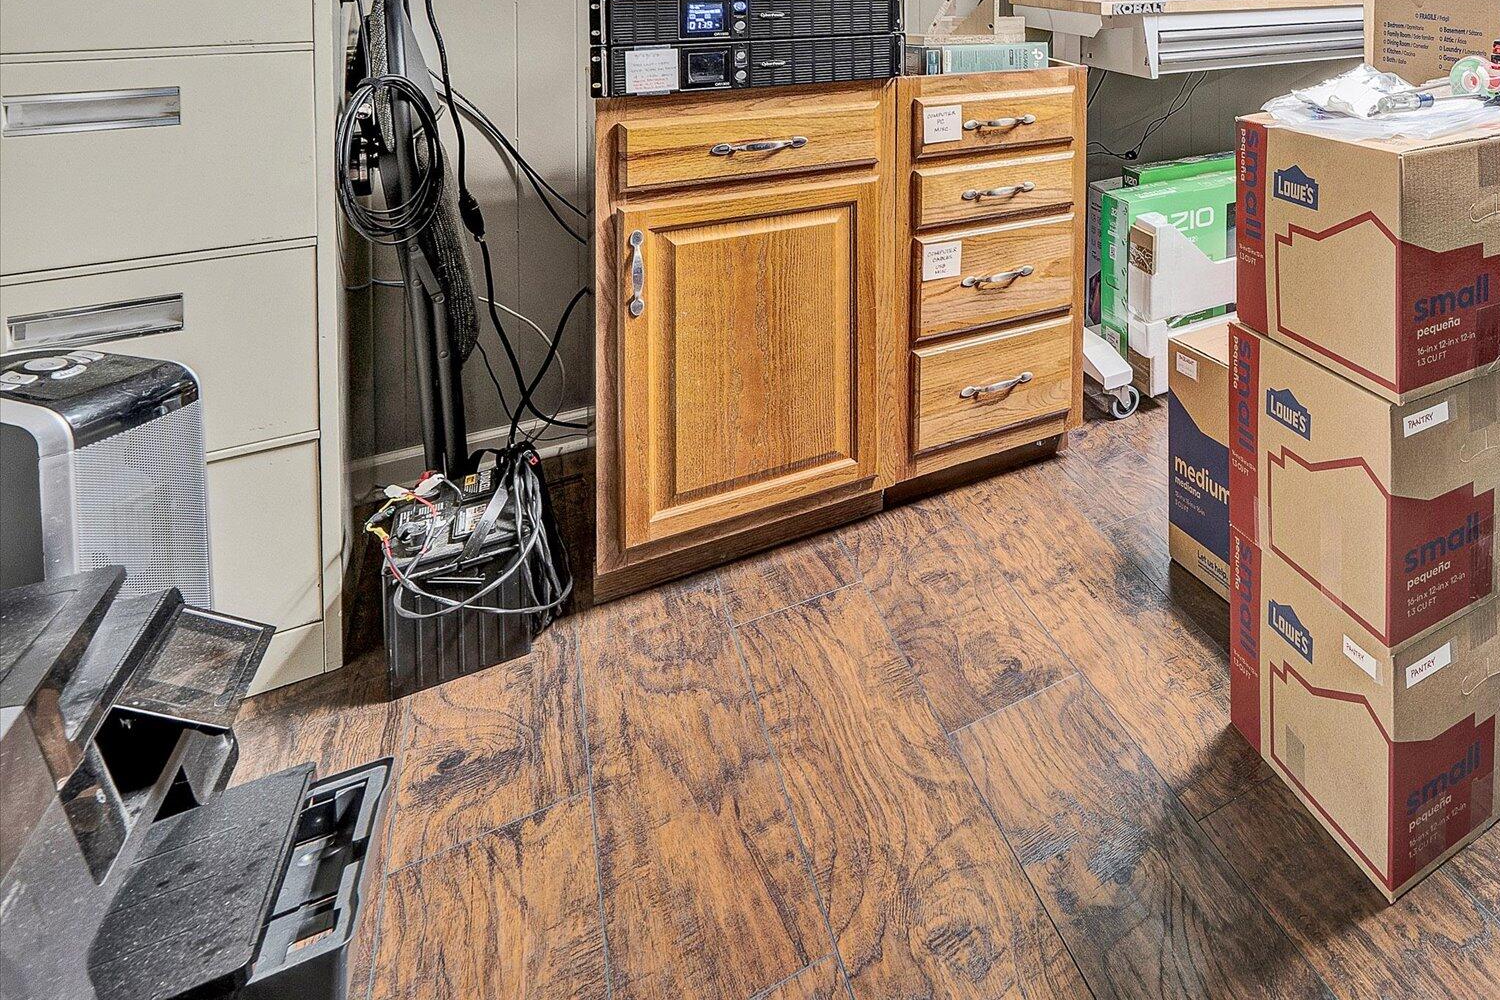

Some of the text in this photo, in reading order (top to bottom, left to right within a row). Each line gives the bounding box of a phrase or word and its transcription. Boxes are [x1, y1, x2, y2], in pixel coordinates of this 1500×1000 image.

[1113, 2, 1166, 15] KOBALT
[1443, 46, 1461, 54] Laundry
[927, 111, 956, 119] COMPUTER
[1245, 130, 1262, 240] small
[1278, 175, 1314, 205] LOWE'S
[927, 247, 957, 257] COMPUTER
[1414, 273, 1490, 323] small
[1417, 317, 1461, 340] pequeña
[1417, 351, 1447, 367] 1.3 CU FT
[1237, 338, 1255, 454] small
[1270, 394, 1307, 433] LOWE'S
[1408, 411, 1434, 429] PANTRY
[1174, 476, 1201, 499] mediana
[1404, 511, 1481, 575] small
[1197, 549, 1206, 566] Let
[1214, 560, 1228, 581] help.
[1407, 560, 1451, 590] pequeña
[1272, 606, 1308, 655] LOWE'S
[1410, 656, 1437, 678] PANTRY
[1406, 739, 1482, 817] small
[1409, 793, 1452, 833] pequeña
